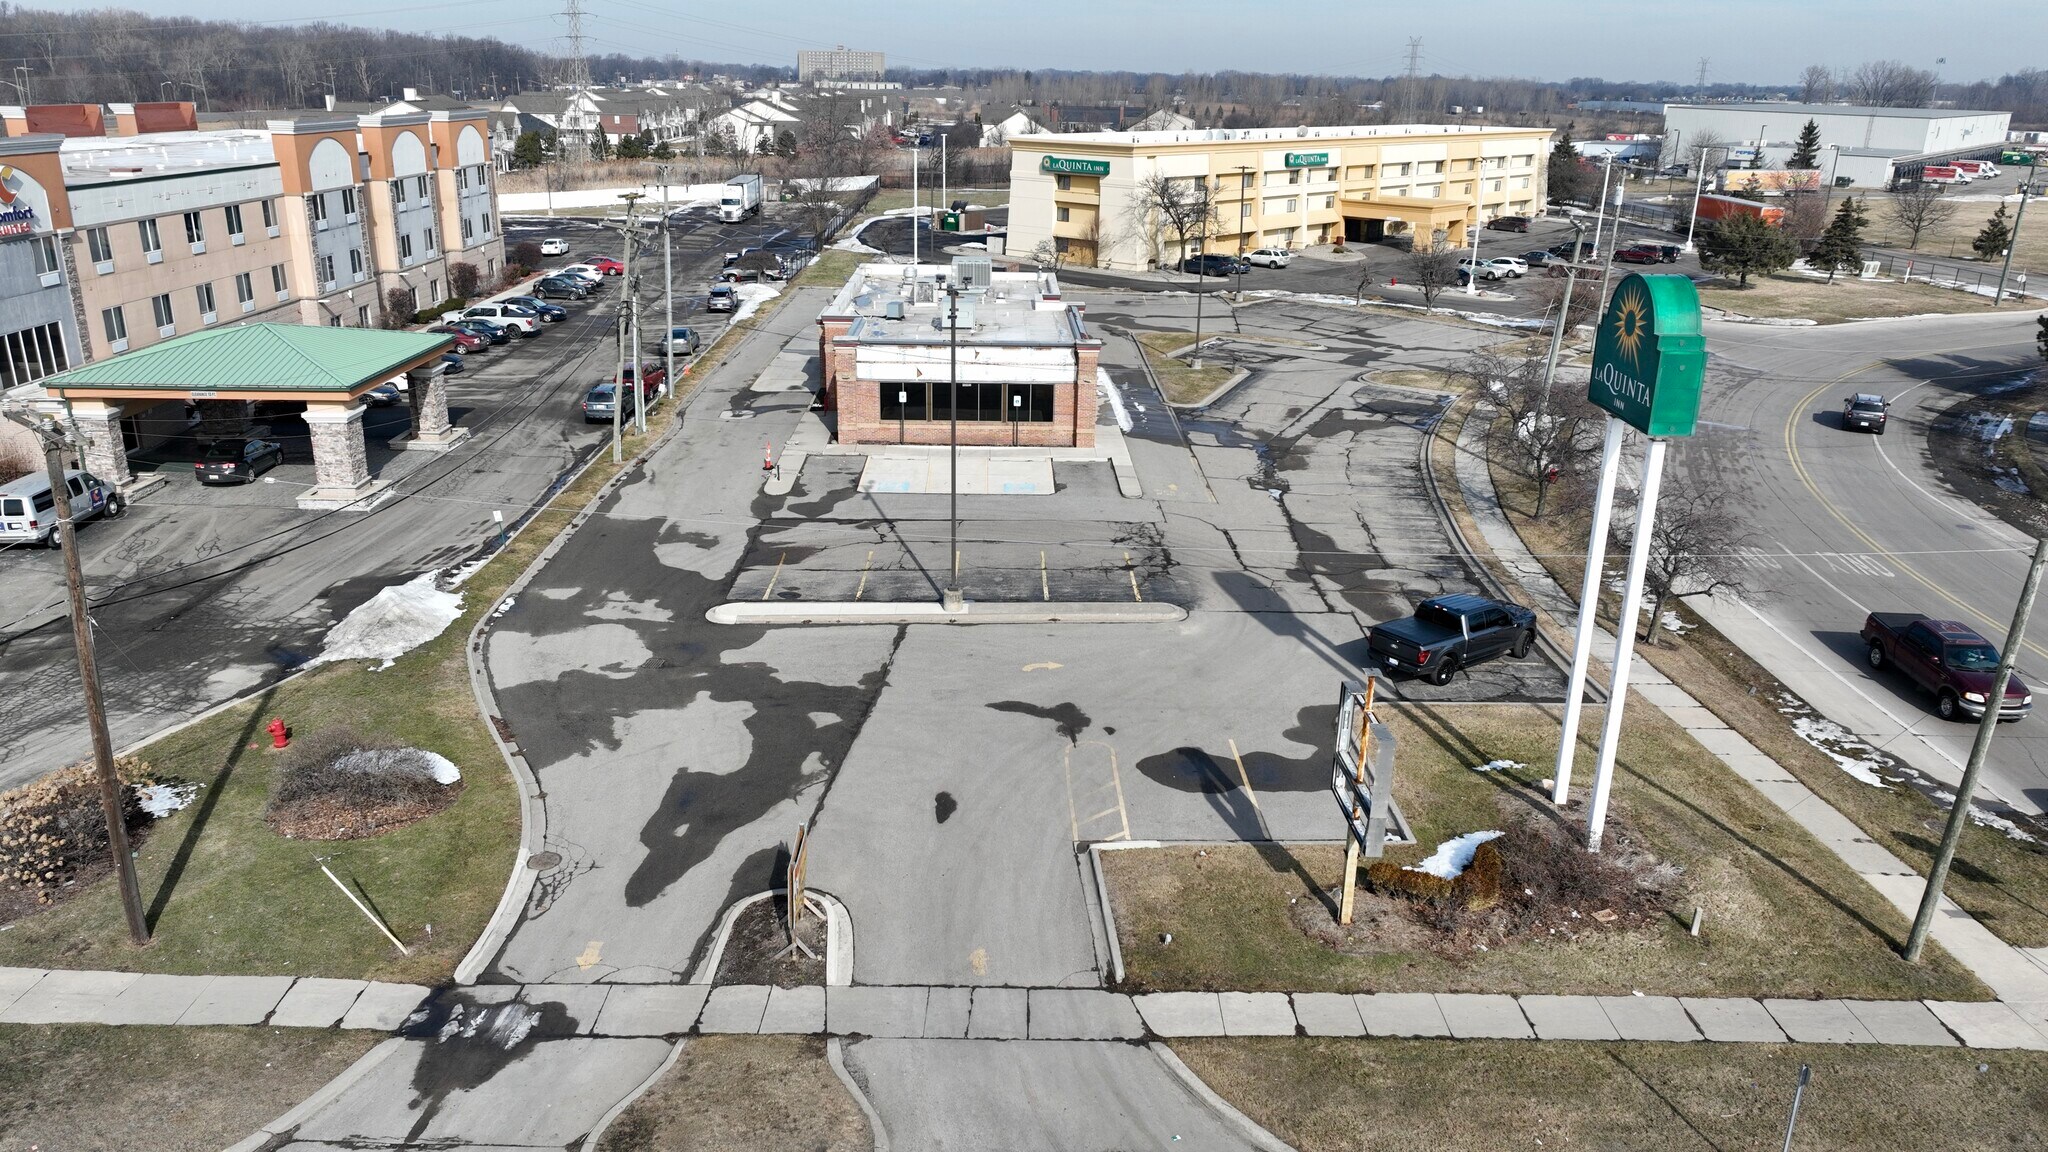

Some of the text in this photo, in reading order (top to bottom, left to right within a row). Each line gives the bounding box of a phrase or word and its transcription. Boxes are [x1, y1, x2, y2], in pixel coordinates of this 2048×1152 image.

[1059, 159, 1092, 172] QUINTA
[1300, 154, 1320, 165] QUINTA
[1594, 362, 1650, 407] LA QUINTA
[1613, 397, 1625, 411] INN
